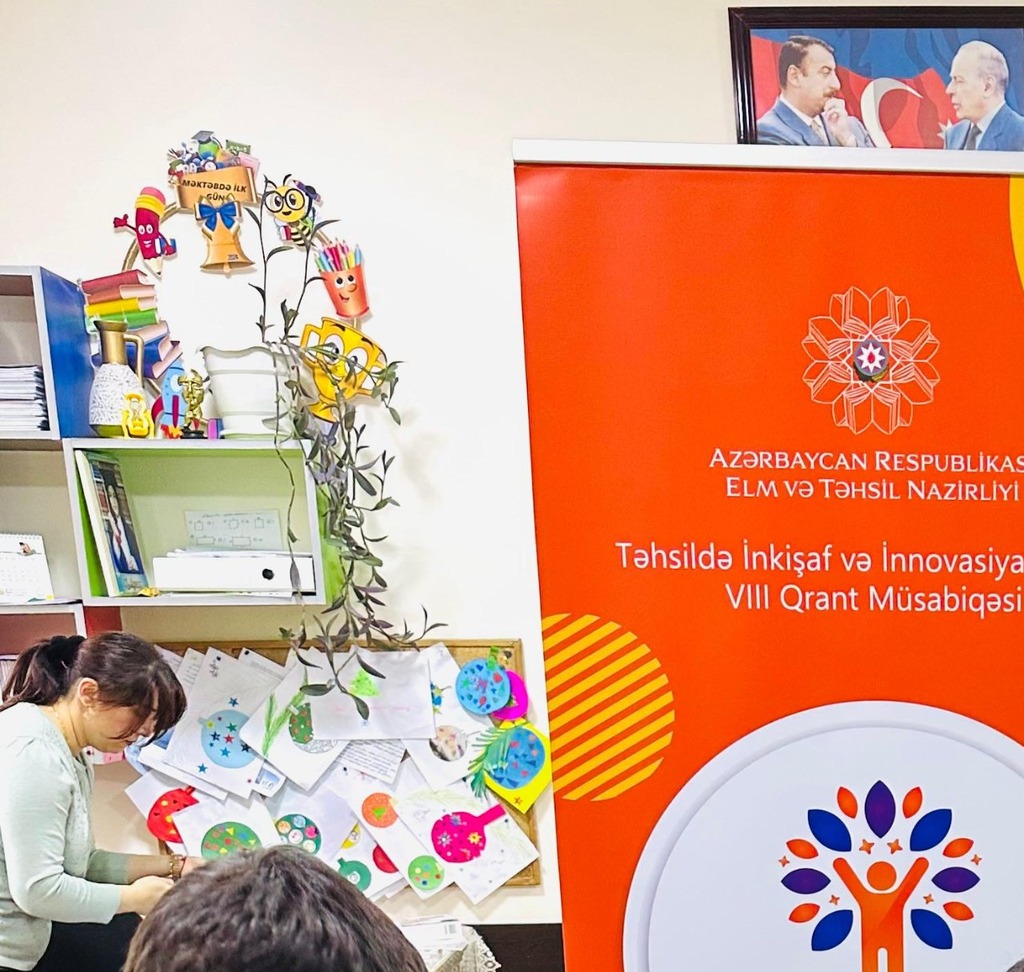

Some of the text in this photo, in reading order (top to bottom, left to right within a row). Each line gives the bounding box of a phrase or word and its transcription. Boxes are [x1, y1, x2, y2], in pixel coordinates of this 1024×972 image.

[181, 179, 247, 193] MƏKTƏBDƏ İLK
[708, 448, 868, 471] AZƏRBAYCAN
[726, 476, 1020, 502] ELM VƏ TƏHSİL NAZİRLİYİ
[615, 541, 734, 571] Təhsildə
[743, 539, 834, 578] İnkişaf
[840, 552, 872, 573] və
[725, 577, 1023, 619] VIII Qrant Müsabiqəsi
